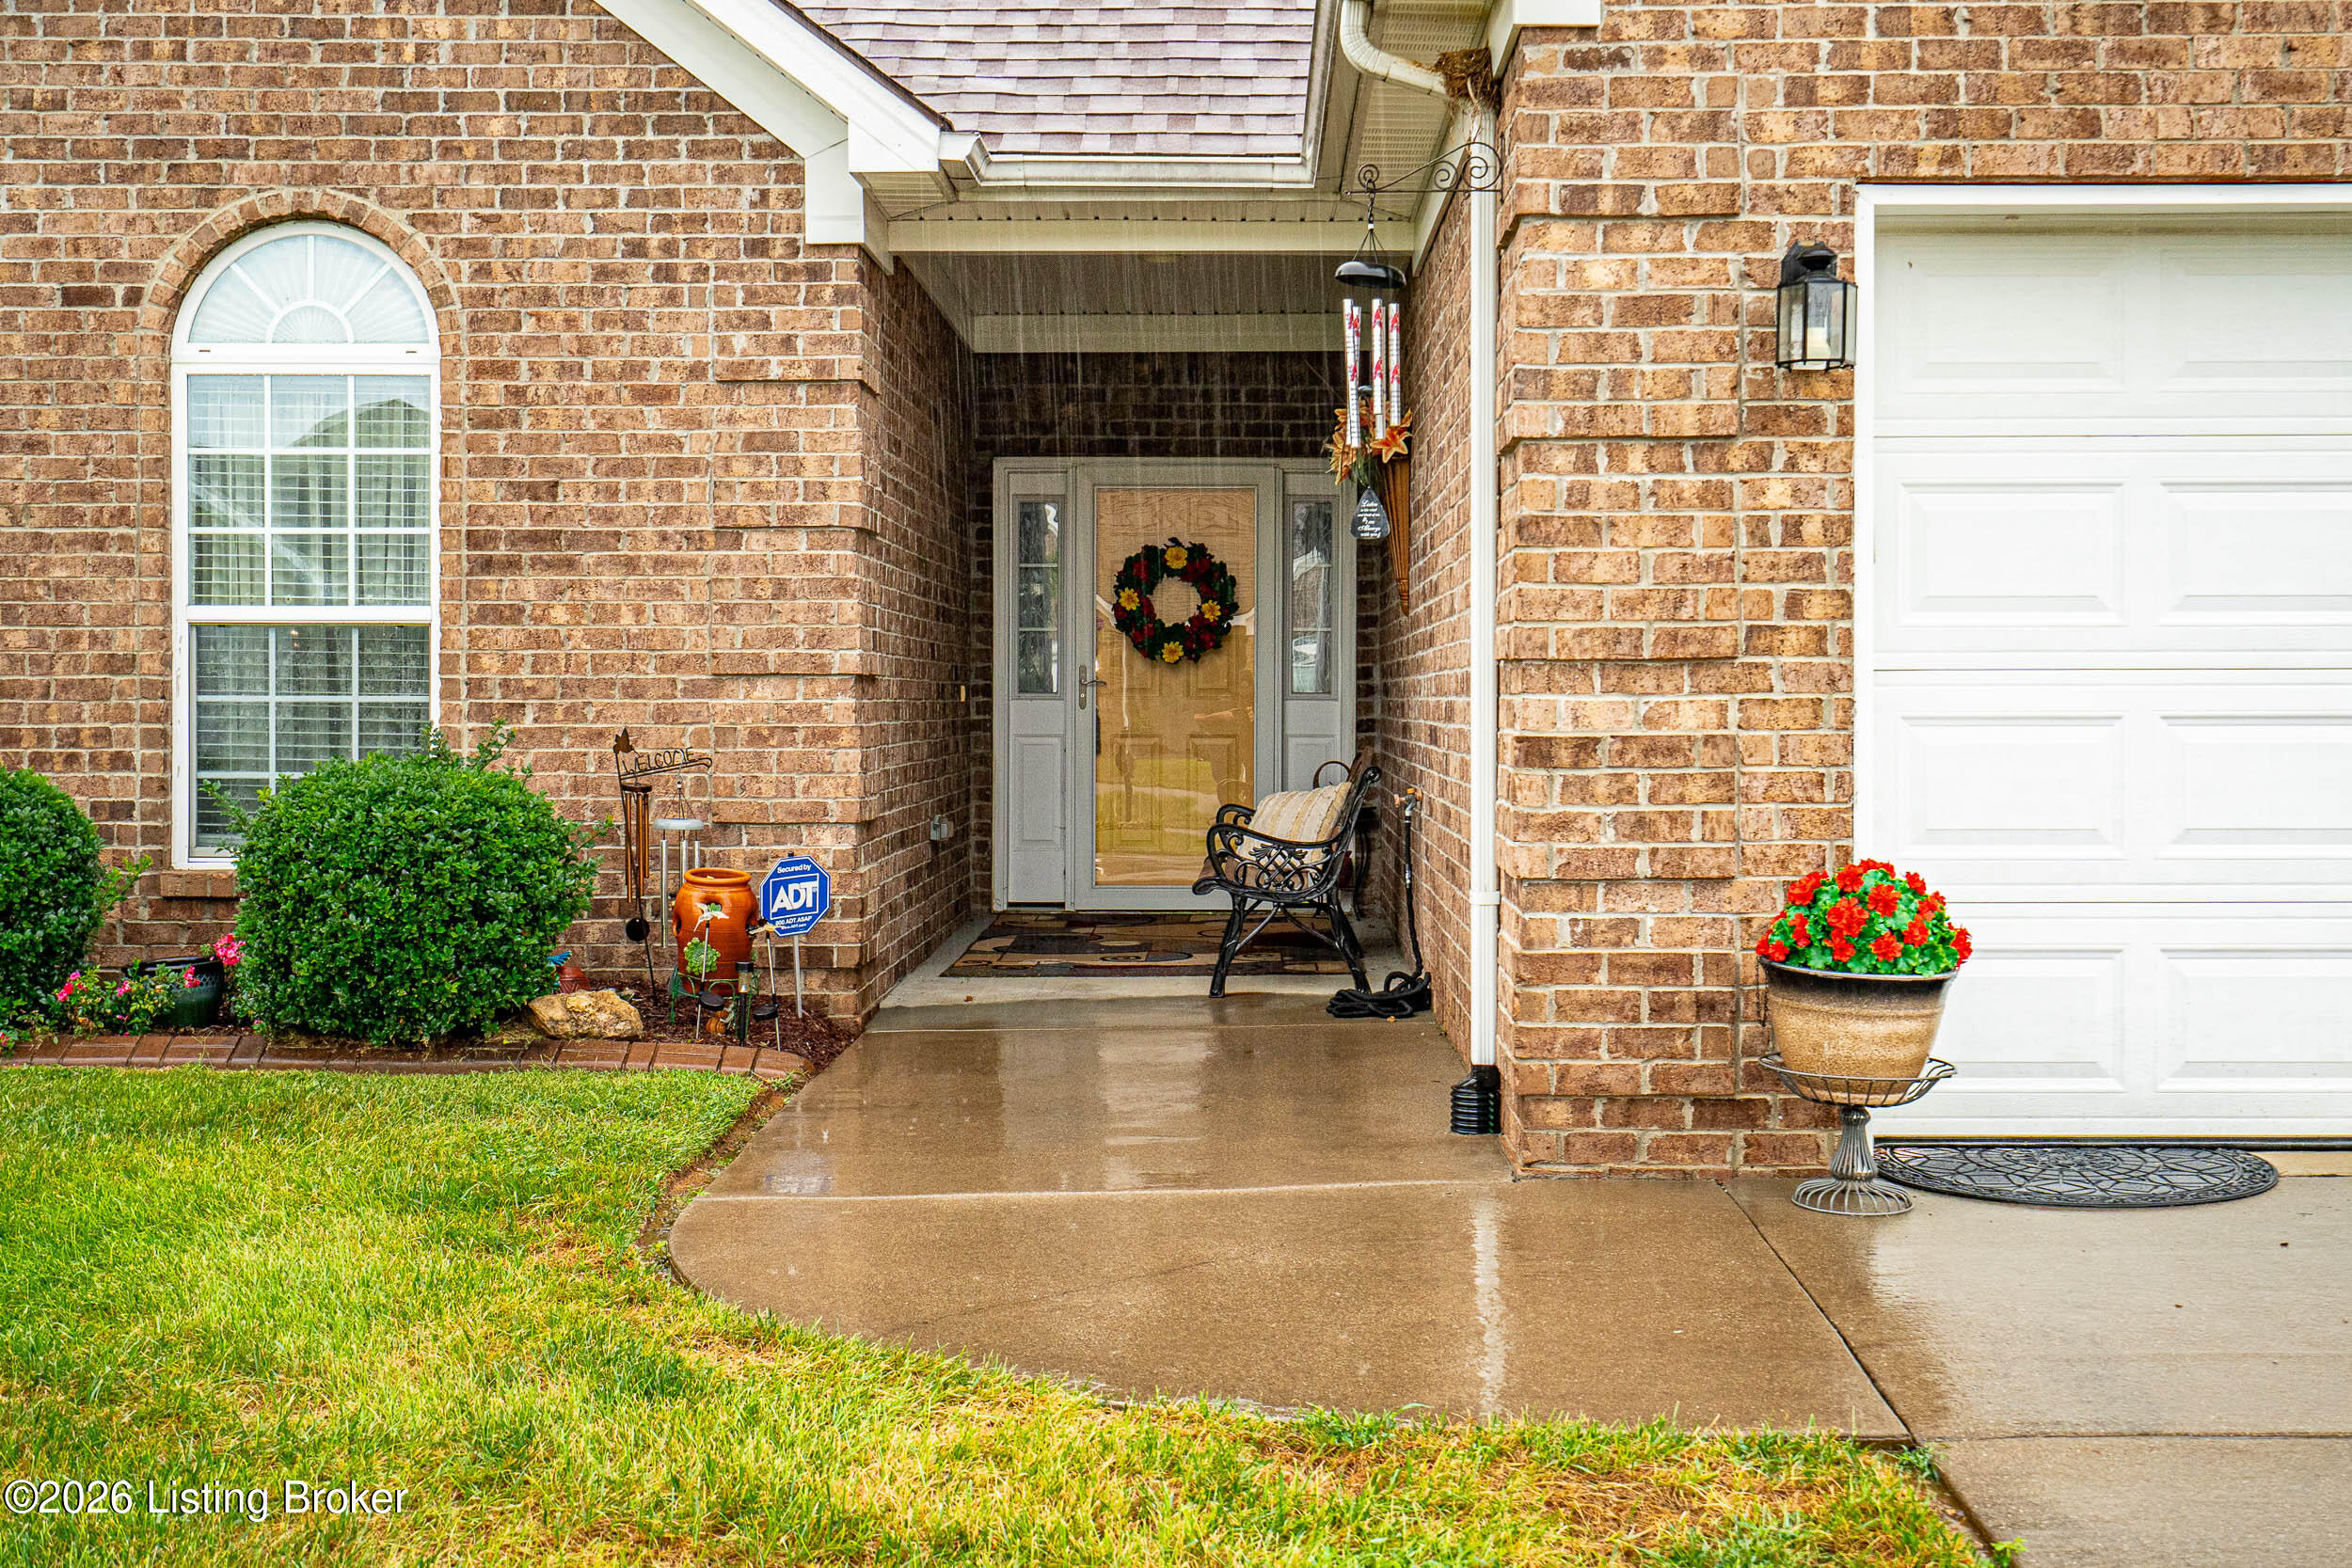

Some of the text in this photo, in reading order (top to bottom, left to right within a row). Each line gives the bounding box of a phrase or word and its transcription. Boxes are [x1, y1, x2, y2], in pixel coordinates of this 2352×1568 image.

[622, 747, 693, 773] WELCOME
[777, 864, 803, 873] Secured
[771, 881, 818, 912] ADT
